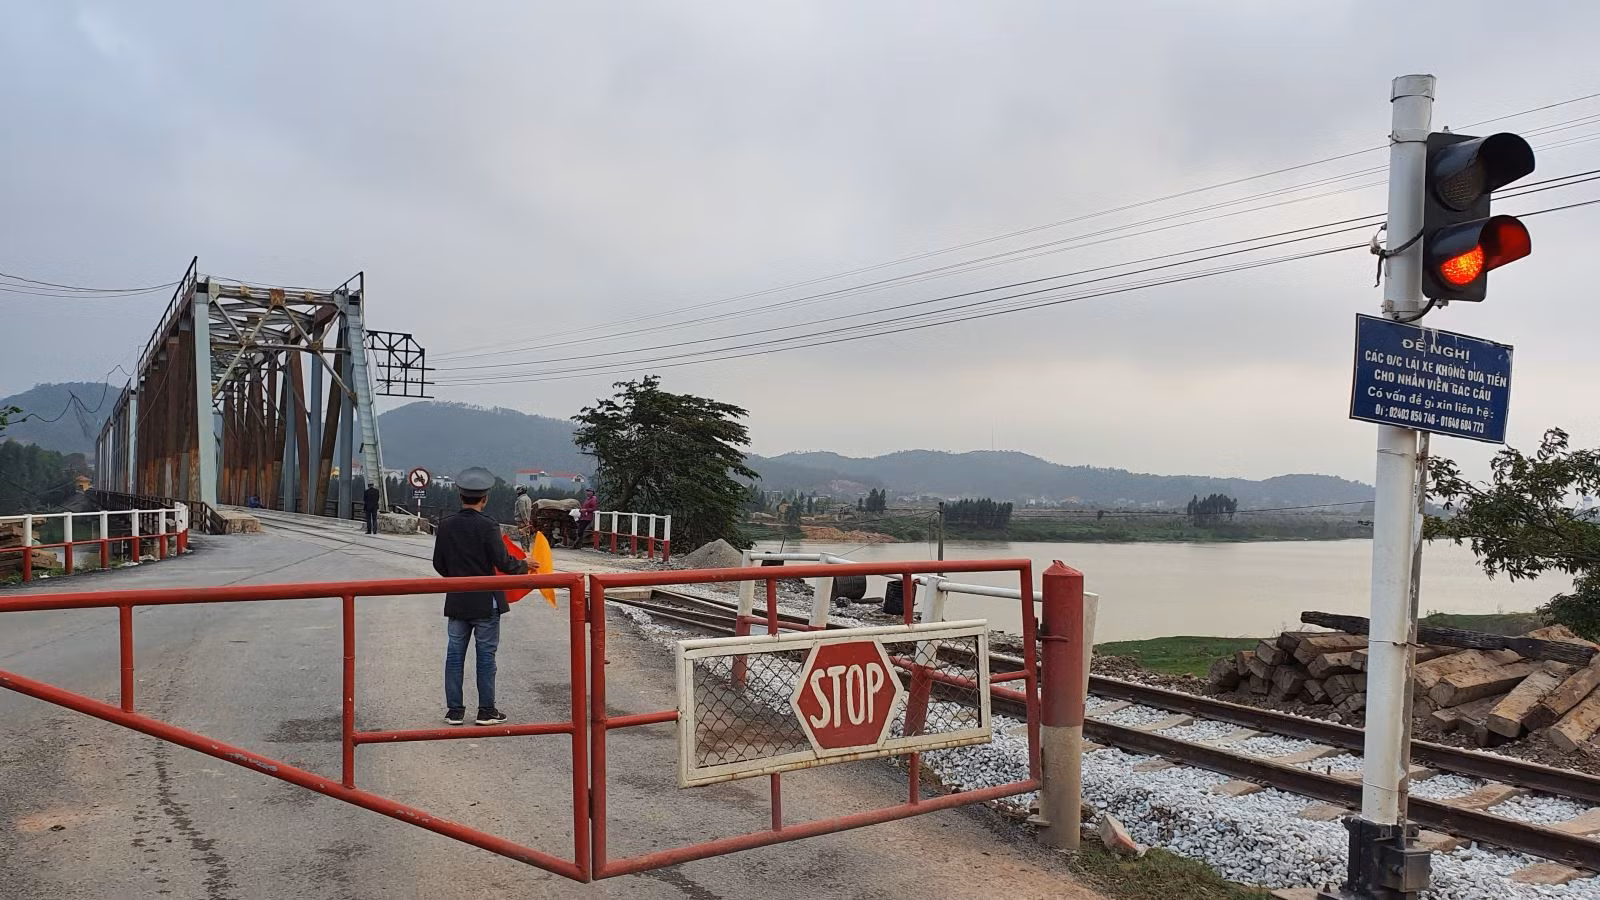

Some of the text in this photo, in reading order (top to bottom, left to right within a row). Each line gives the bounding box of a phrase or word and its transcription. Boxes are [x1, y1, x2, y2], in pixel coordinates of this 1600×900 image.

[1365, 349, 1384, 364] CÁC
[1405, 356, 1419, 370] LÁI
[1421, 360, 1433, 373] XE
[1435, 363, 1466, 380] KHÔNG
[1430, 344, 1470, 363] NGHỊ
[1374, 369, 1395, 382] CHO
[1451, 383, 1470, 397] GÁC
[1367, 386, 1383, 398] Có
[1385, 389, 1406, 403] vấn
[1409, 393, 1422, 405] đề
[1424, 396, 1435, 409] gì
[1436, 400, 1453, 411] xin
[1454, 402, 1473, 415] liên
[1389, 406, 1410, 420] 02403
[1410, 410, 1422, 423] 854
[1440, 415, 1459, 429] 01648
[1460, 420, 1472, 432] 684
[1473, 421, 1484, 433] 773
[809, 662, 885, 729] STOP
